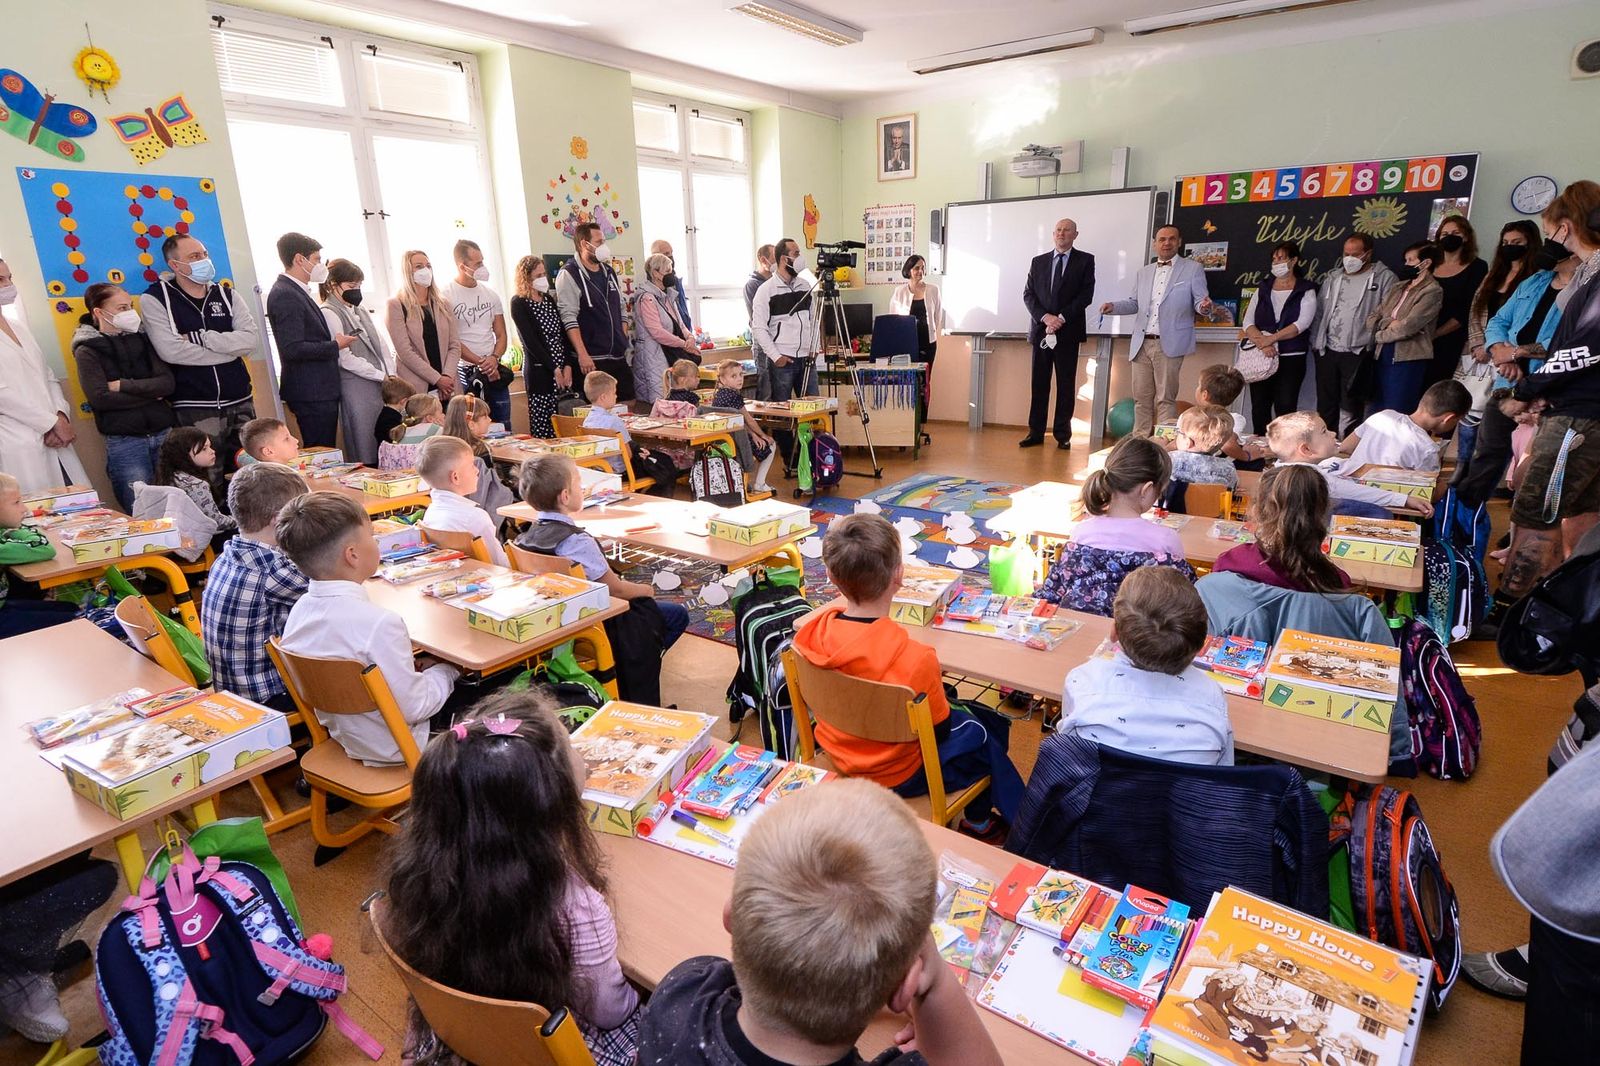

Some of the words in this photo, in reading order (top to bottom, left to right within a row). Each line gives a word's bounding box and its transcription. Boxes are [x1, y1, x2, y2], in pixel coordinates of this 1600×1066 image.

[1188, 182, 1198, 203] 1
[1208, 180, 1224, 202] 2
[1231, 178, 1247, 200] 3
[1253, 176, 1271, 198] 4
[1278, 174, 1296, 197] 5
[1303, 172, 1320, 195] 6
[1329, 170, 1347, 193] 7
[1354, 168, 1374, 192] 8
[1383, 166, 1402, 190] 9
[1409, 164, 1442, 188] 10
[1256, 211, 1346, 252] Vítejte
[453, 296, 495, 327] Replay
[1293, 633, 1335, 646] Happy
[1336, 640, 1377, 653] House
[609, 709, 648, 722] Happy
[649, 713, 683, 727] House
[1231, 905, 1302, 943] Happy
[1308, 931, 1376, 973] House
[1172, 1020, 1211, 1043] OXFORD
